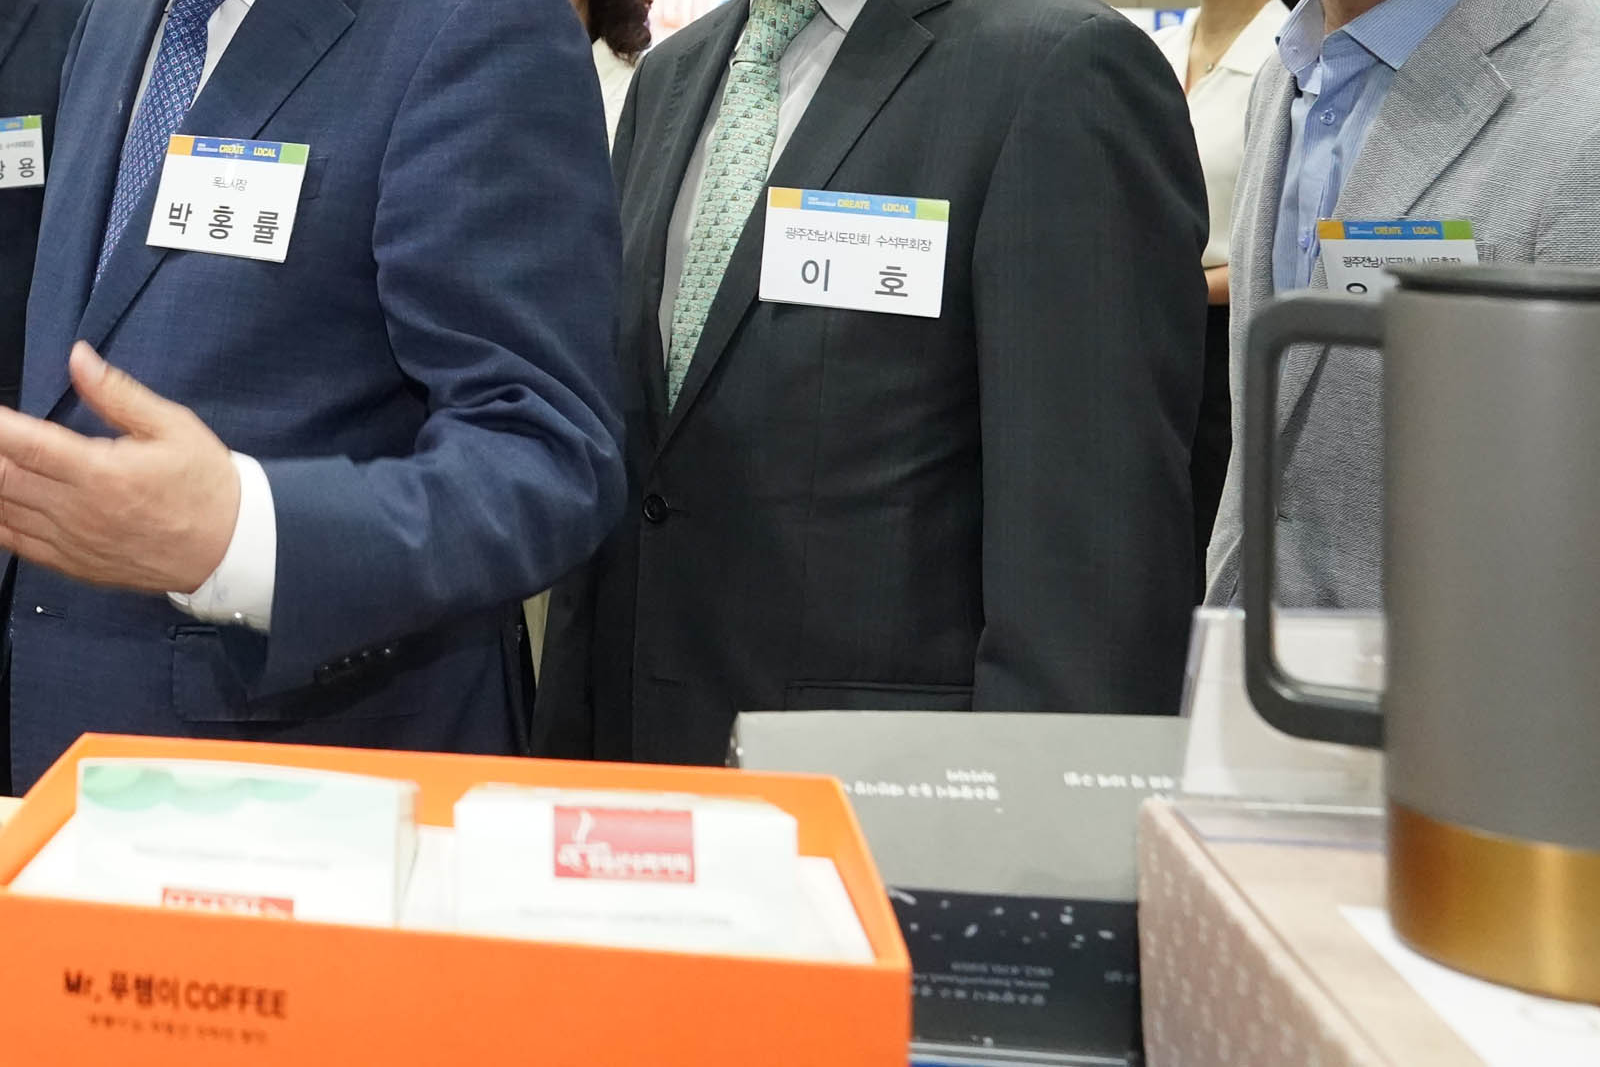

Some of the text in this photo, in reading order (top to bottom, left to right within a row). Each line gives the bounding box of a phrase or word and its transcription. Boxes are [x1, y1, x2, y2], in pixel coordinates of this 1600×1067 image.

[168, 201, 280, 245] 박홍률
[784, 226, 933, 253] 광주전남시도민회 수석부회장
[800, 258, 909, 298] 이호
